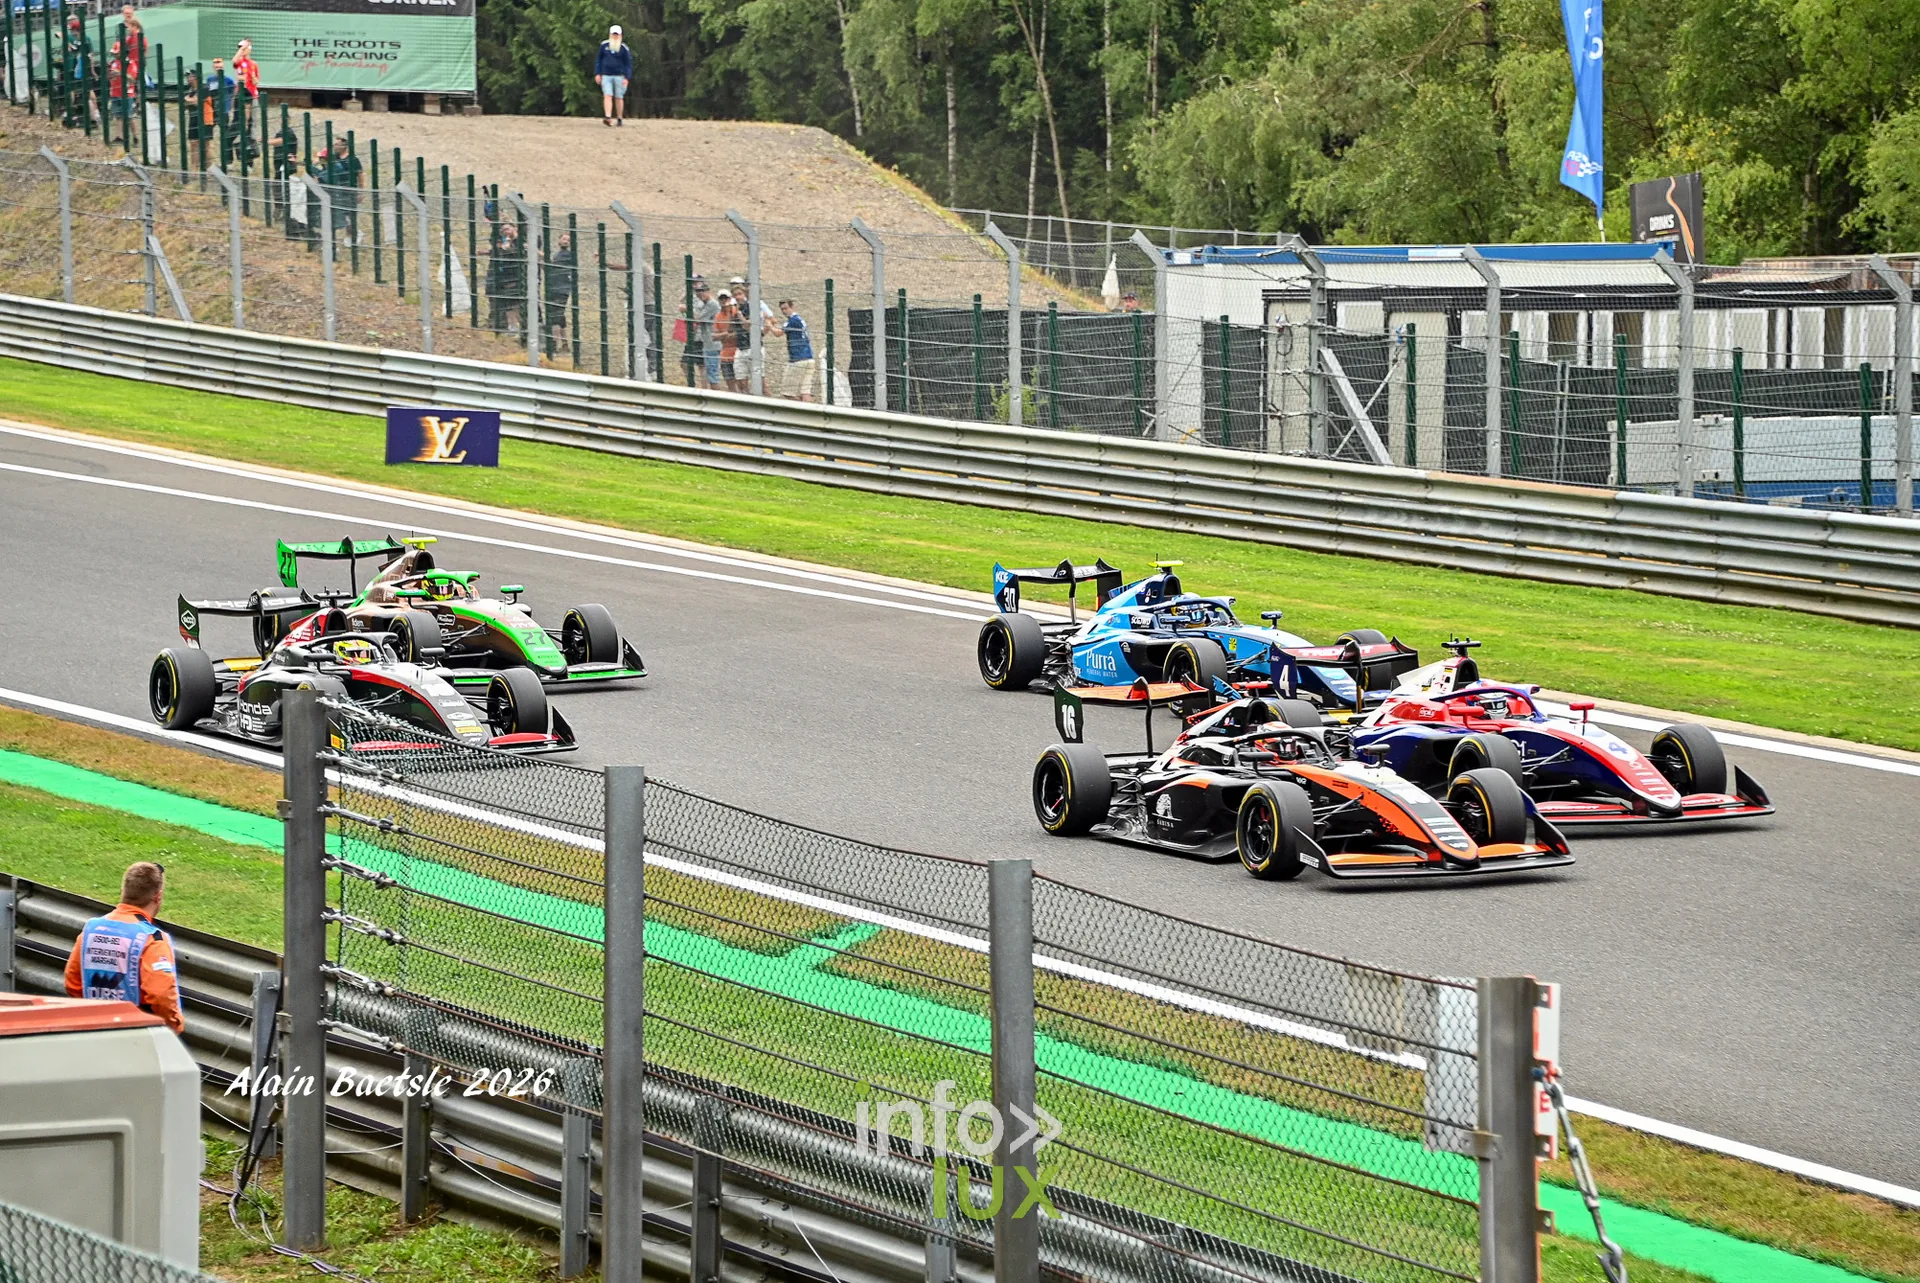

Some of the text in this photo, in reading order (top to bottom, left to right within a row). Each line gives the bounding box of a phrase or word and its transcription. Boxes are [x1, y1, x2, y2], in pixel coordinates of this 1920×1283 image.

[289, 38, 402, 49] THE ROOTS
[293, 50, 398, 61] OF RACING
[1003, 586, 1017, 613] 30
[520, 631, 546, 646] 27
[1086, 649, 1117, 672] Purrá
[1279, 664, 1291, 697] 4
[1061, 704, 1077, 740] 16
